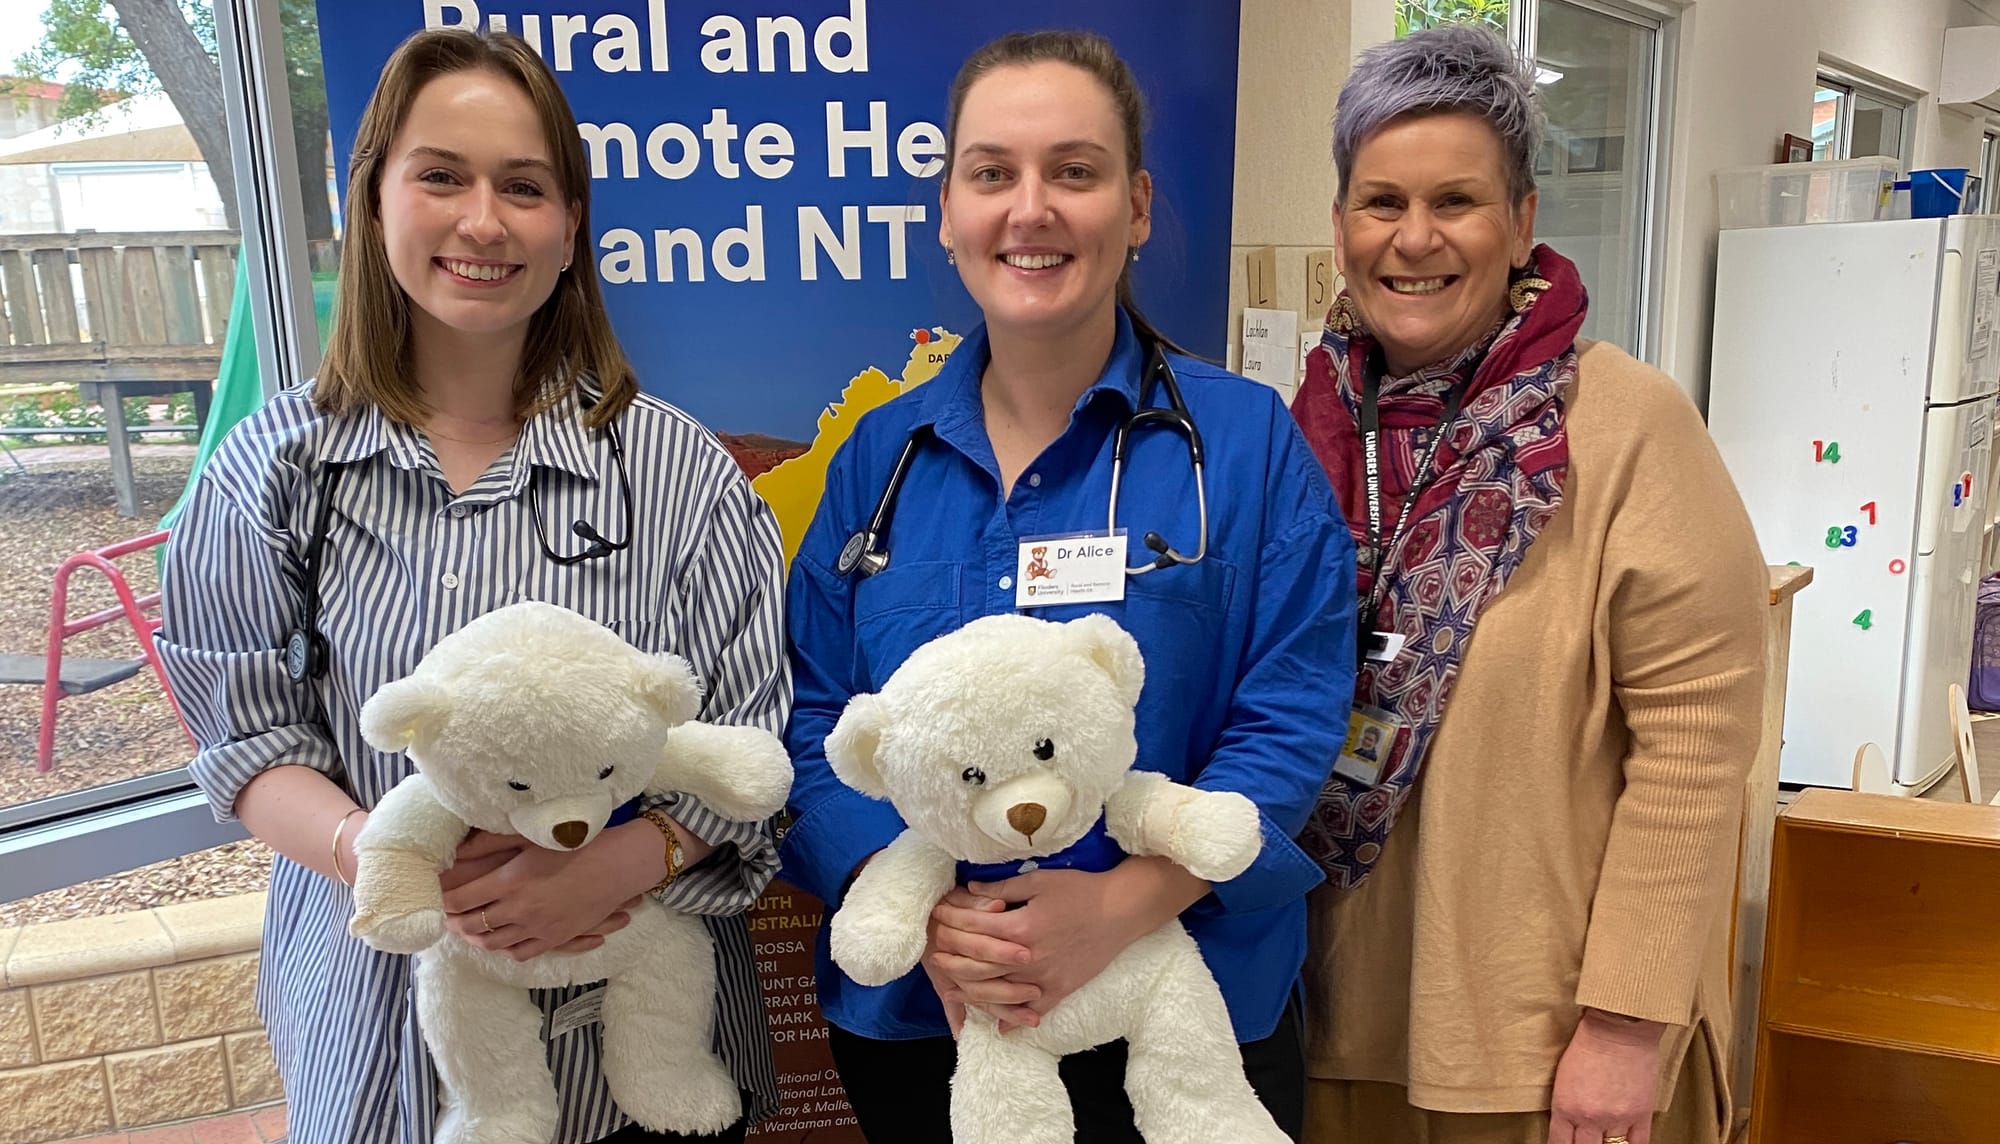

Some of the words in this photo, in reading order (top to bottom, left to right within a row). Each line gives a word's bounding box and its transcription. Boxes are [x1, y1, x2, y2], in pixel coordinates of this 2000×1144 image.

[700, 0, 869, 74] and
[600, 205, 766, 284] and
[798, 205, 926, 282] NT
[1365, 430, 1378, 476] FLINDERS
[1367, 476, 1380, 534] UNIVERSITY
[1057, 547, 1073, 560] Dr
[1076, 545, 1114, 558] Alice
[1852, 608, 1872, 630] 4
[754, 940, 806, 956] ROSSA
[760, 976, 795, 991] UNT
[768, 1010, 814, 1027] MARK
[778, 1086, 819, 1101] itional
[821, 1086, 847, 1097] Lan
[802, 1102, 812, 1114] &
[764, 1118, 832, 1133] Wardaman
